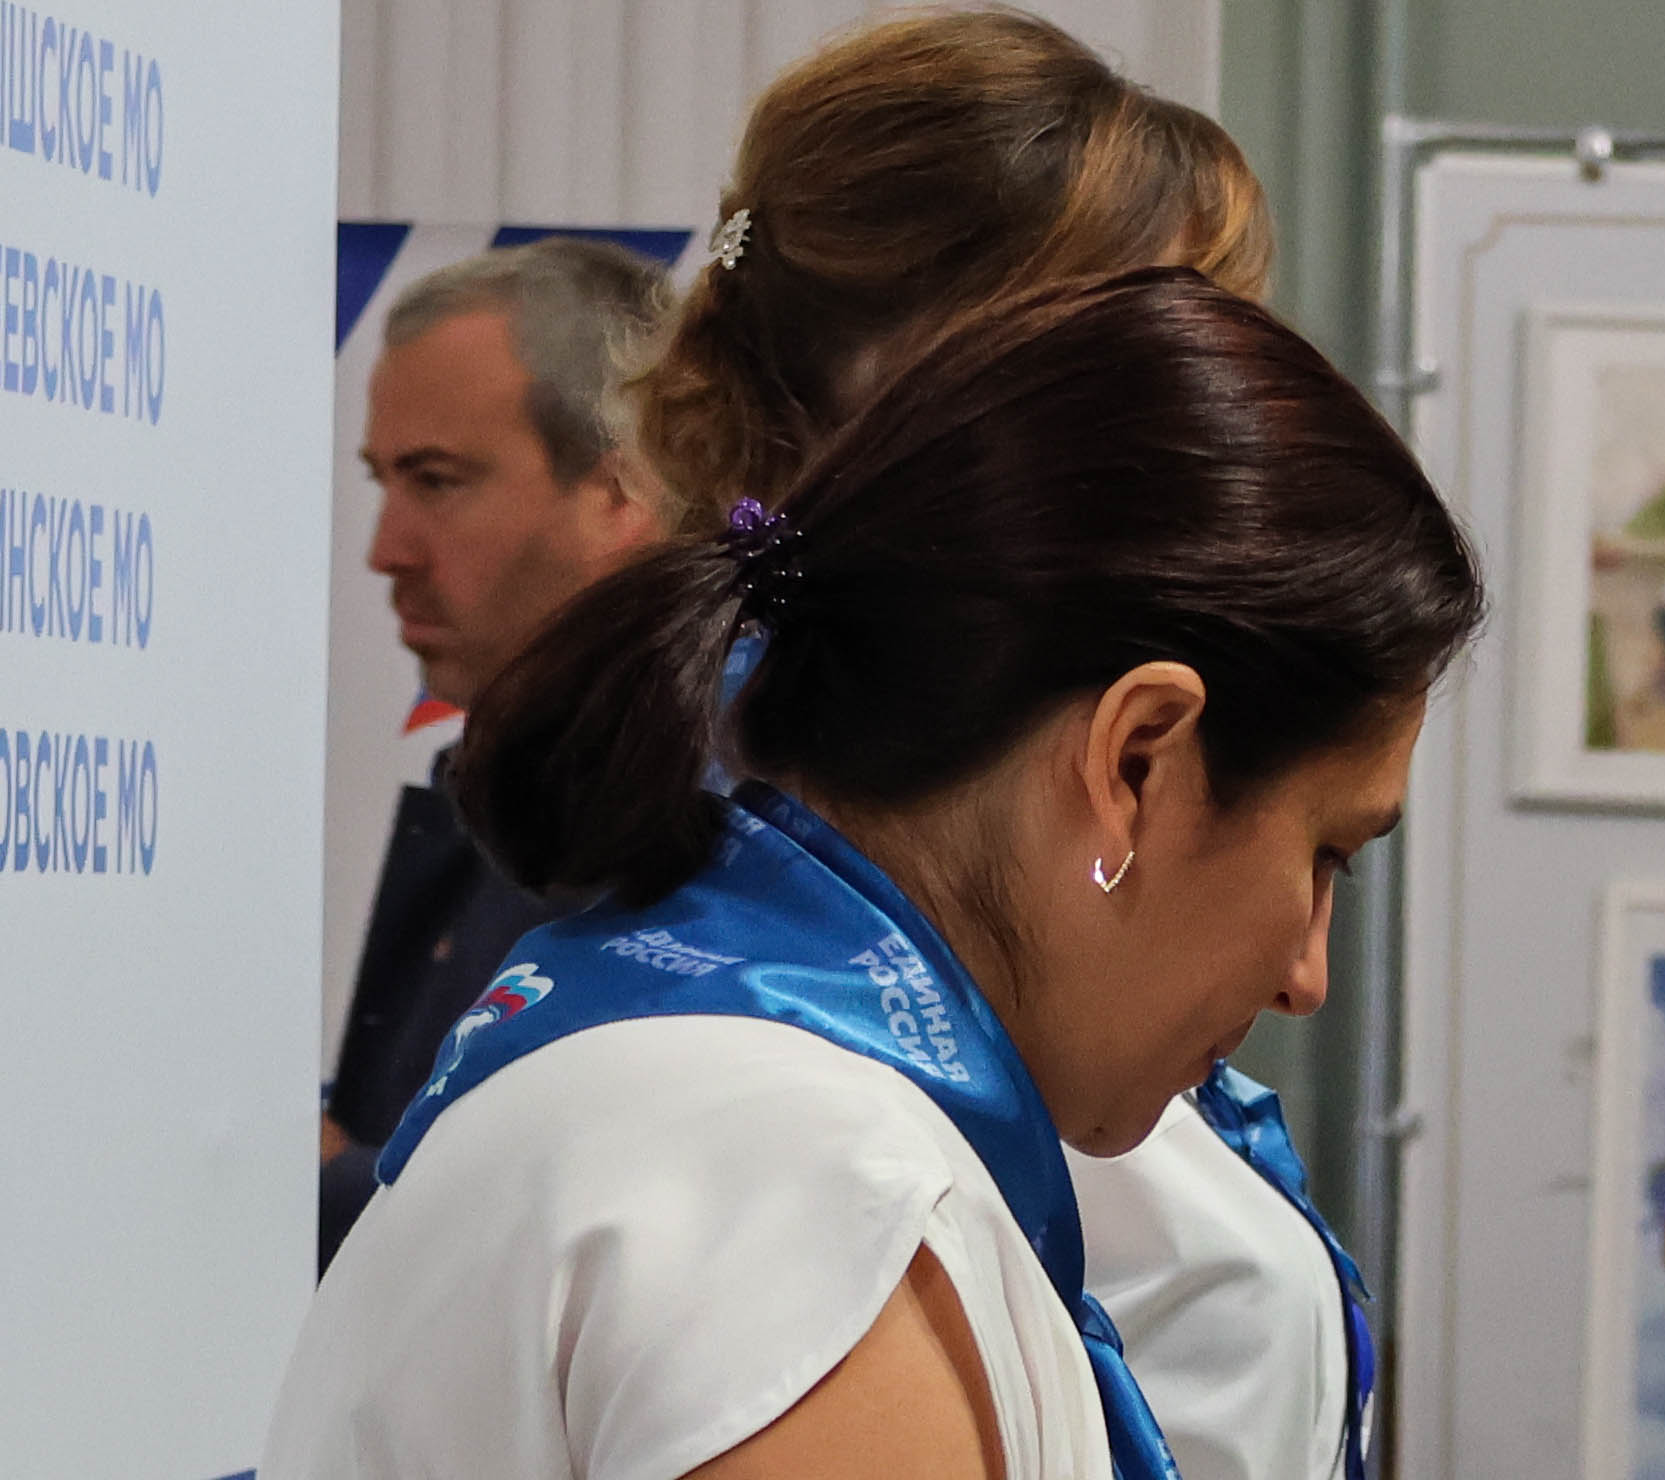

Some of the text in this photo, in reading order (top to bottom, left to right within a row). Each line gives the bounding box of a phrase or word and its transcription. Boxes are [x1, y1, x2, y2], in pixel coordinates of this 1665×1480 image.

[122, 50, 164, 199] МО
[123, 279, 166, 426] МО
[113, 510, 154, 650] МО
[118, 740, 158, 877] МО
[847, 948, 948, 1081] РОССИЯ
[877, 932, 971, 1083] ЕДИНАЯ
